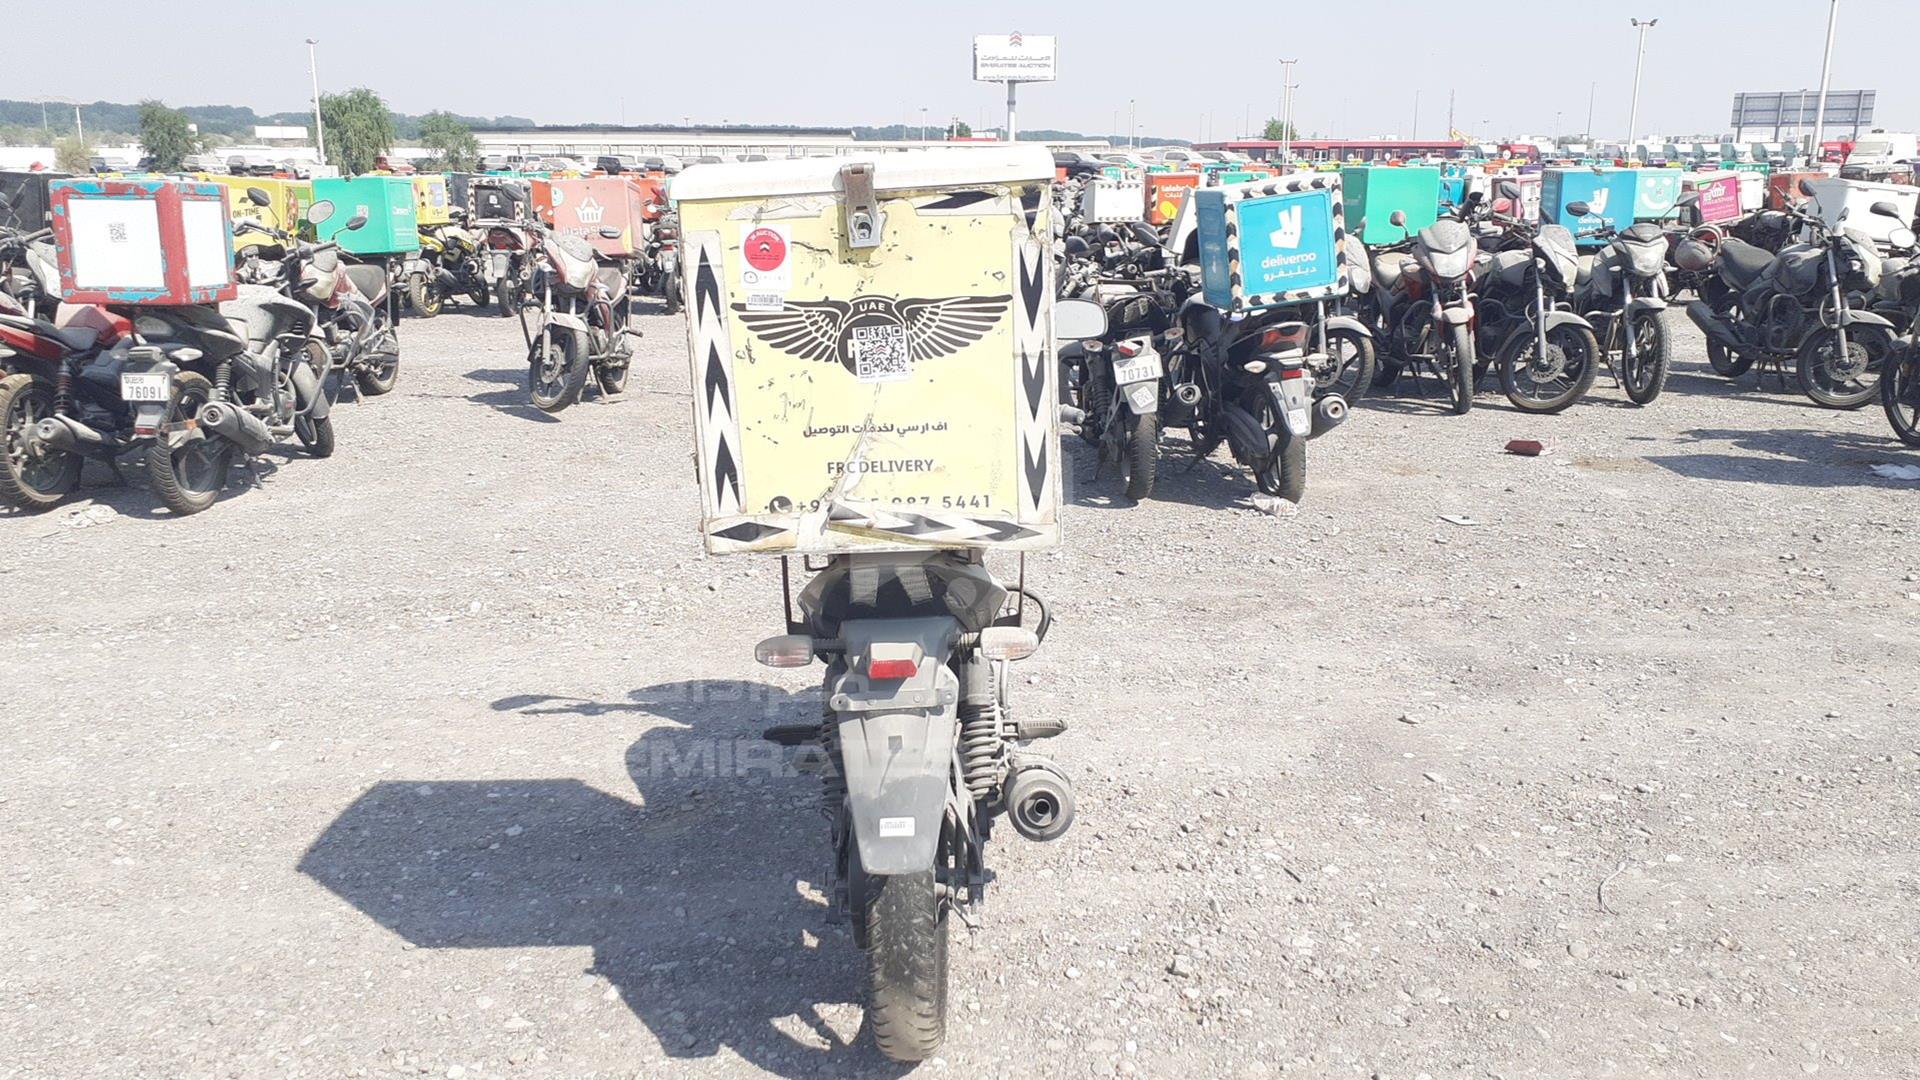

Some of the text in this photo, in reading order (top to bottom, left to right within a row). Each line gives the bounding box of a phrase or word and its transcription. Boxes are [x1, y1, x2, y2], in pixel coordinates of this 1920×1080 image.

[232, 207, 260, 218] ON-TIME
[1261, 252, 1317, 268] deliveroo
[859, 302, 886, 312] UAE
[1121, 366, 1155, 381] 70731
[128, 386, 162, 399] 76091
[803, 424, 849, 438] التوصيل
[931, 421, 948, 431] اف
[827, 459, 934, 474] FRC DELIVERY
[942, 495, 990, 509] 5441
